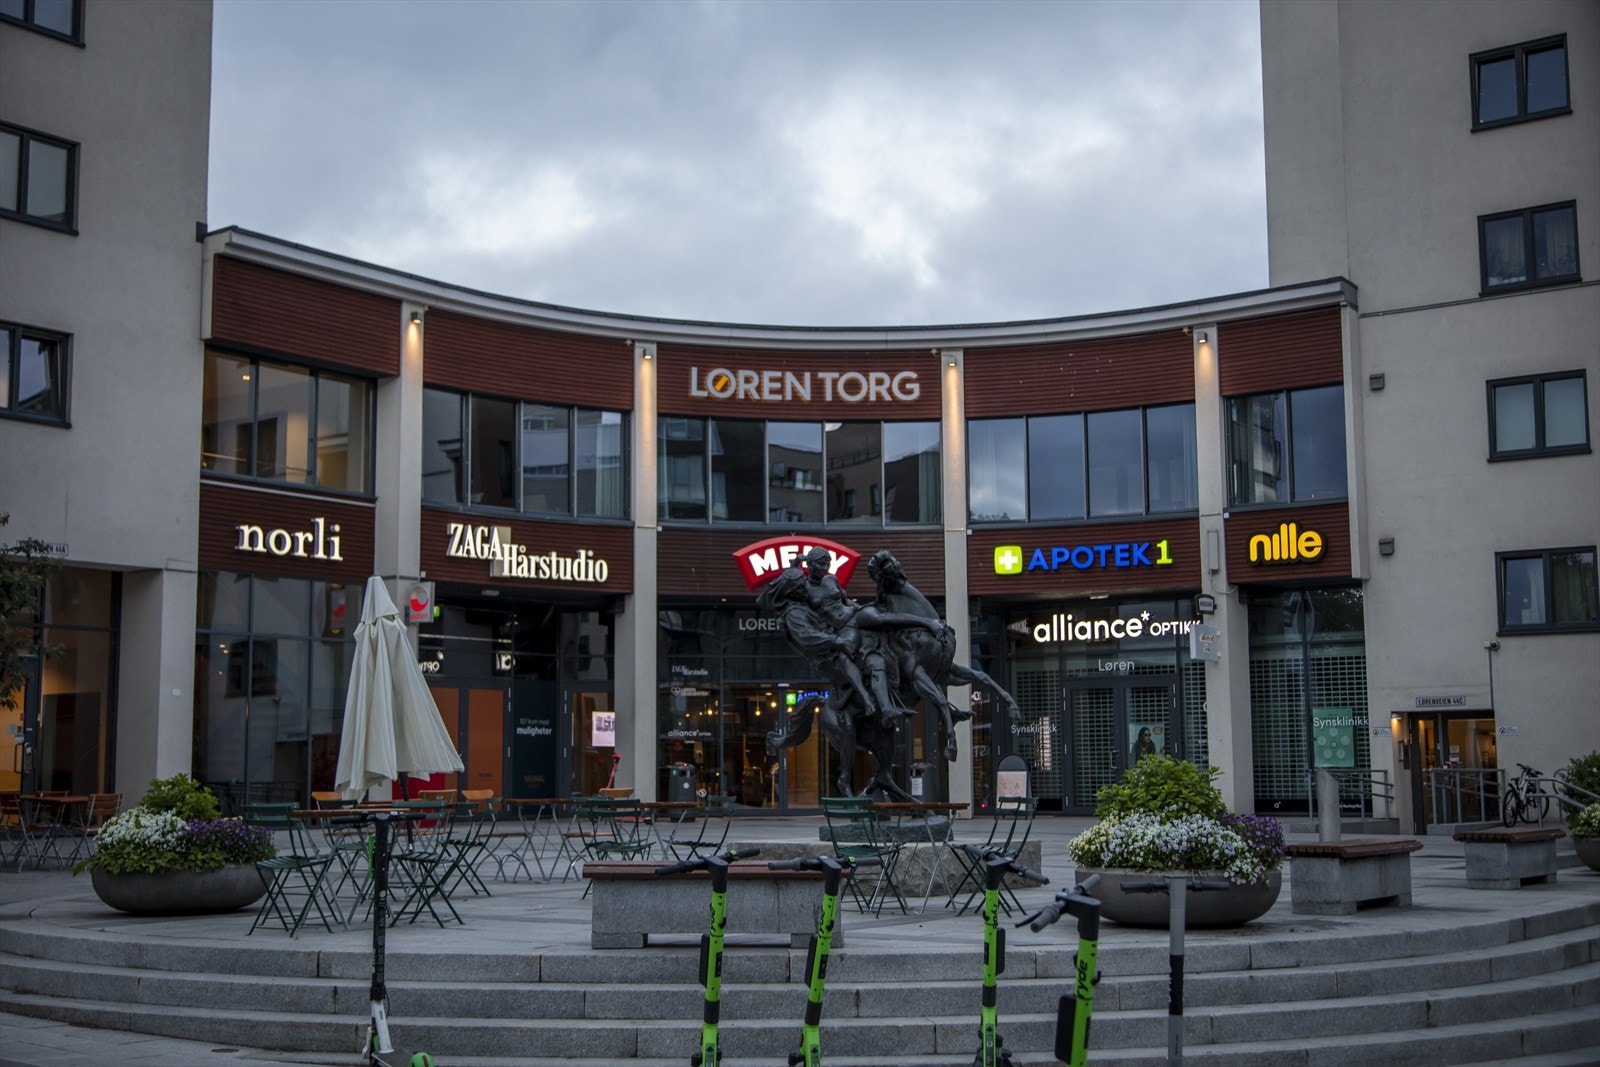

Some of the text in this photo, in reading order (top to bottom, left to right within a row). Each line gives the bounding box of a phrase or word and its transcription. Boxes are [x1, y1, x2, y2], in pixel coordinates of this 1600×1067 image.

[691, 366, 920, 402] LØREN TORG
[235, 517, 343, 562] norli
[448, 522, 608, 583] ZAGA Hårstudio
[1027, 539, 1173, 572] APOTEK 1
[1249, 521, 1323, 563] nille
[1098, 658, 1135, 672] Løren
[1313, 716, 1369, 730] Synsklinikk
[1075, 959, 1088, 999] ryde
